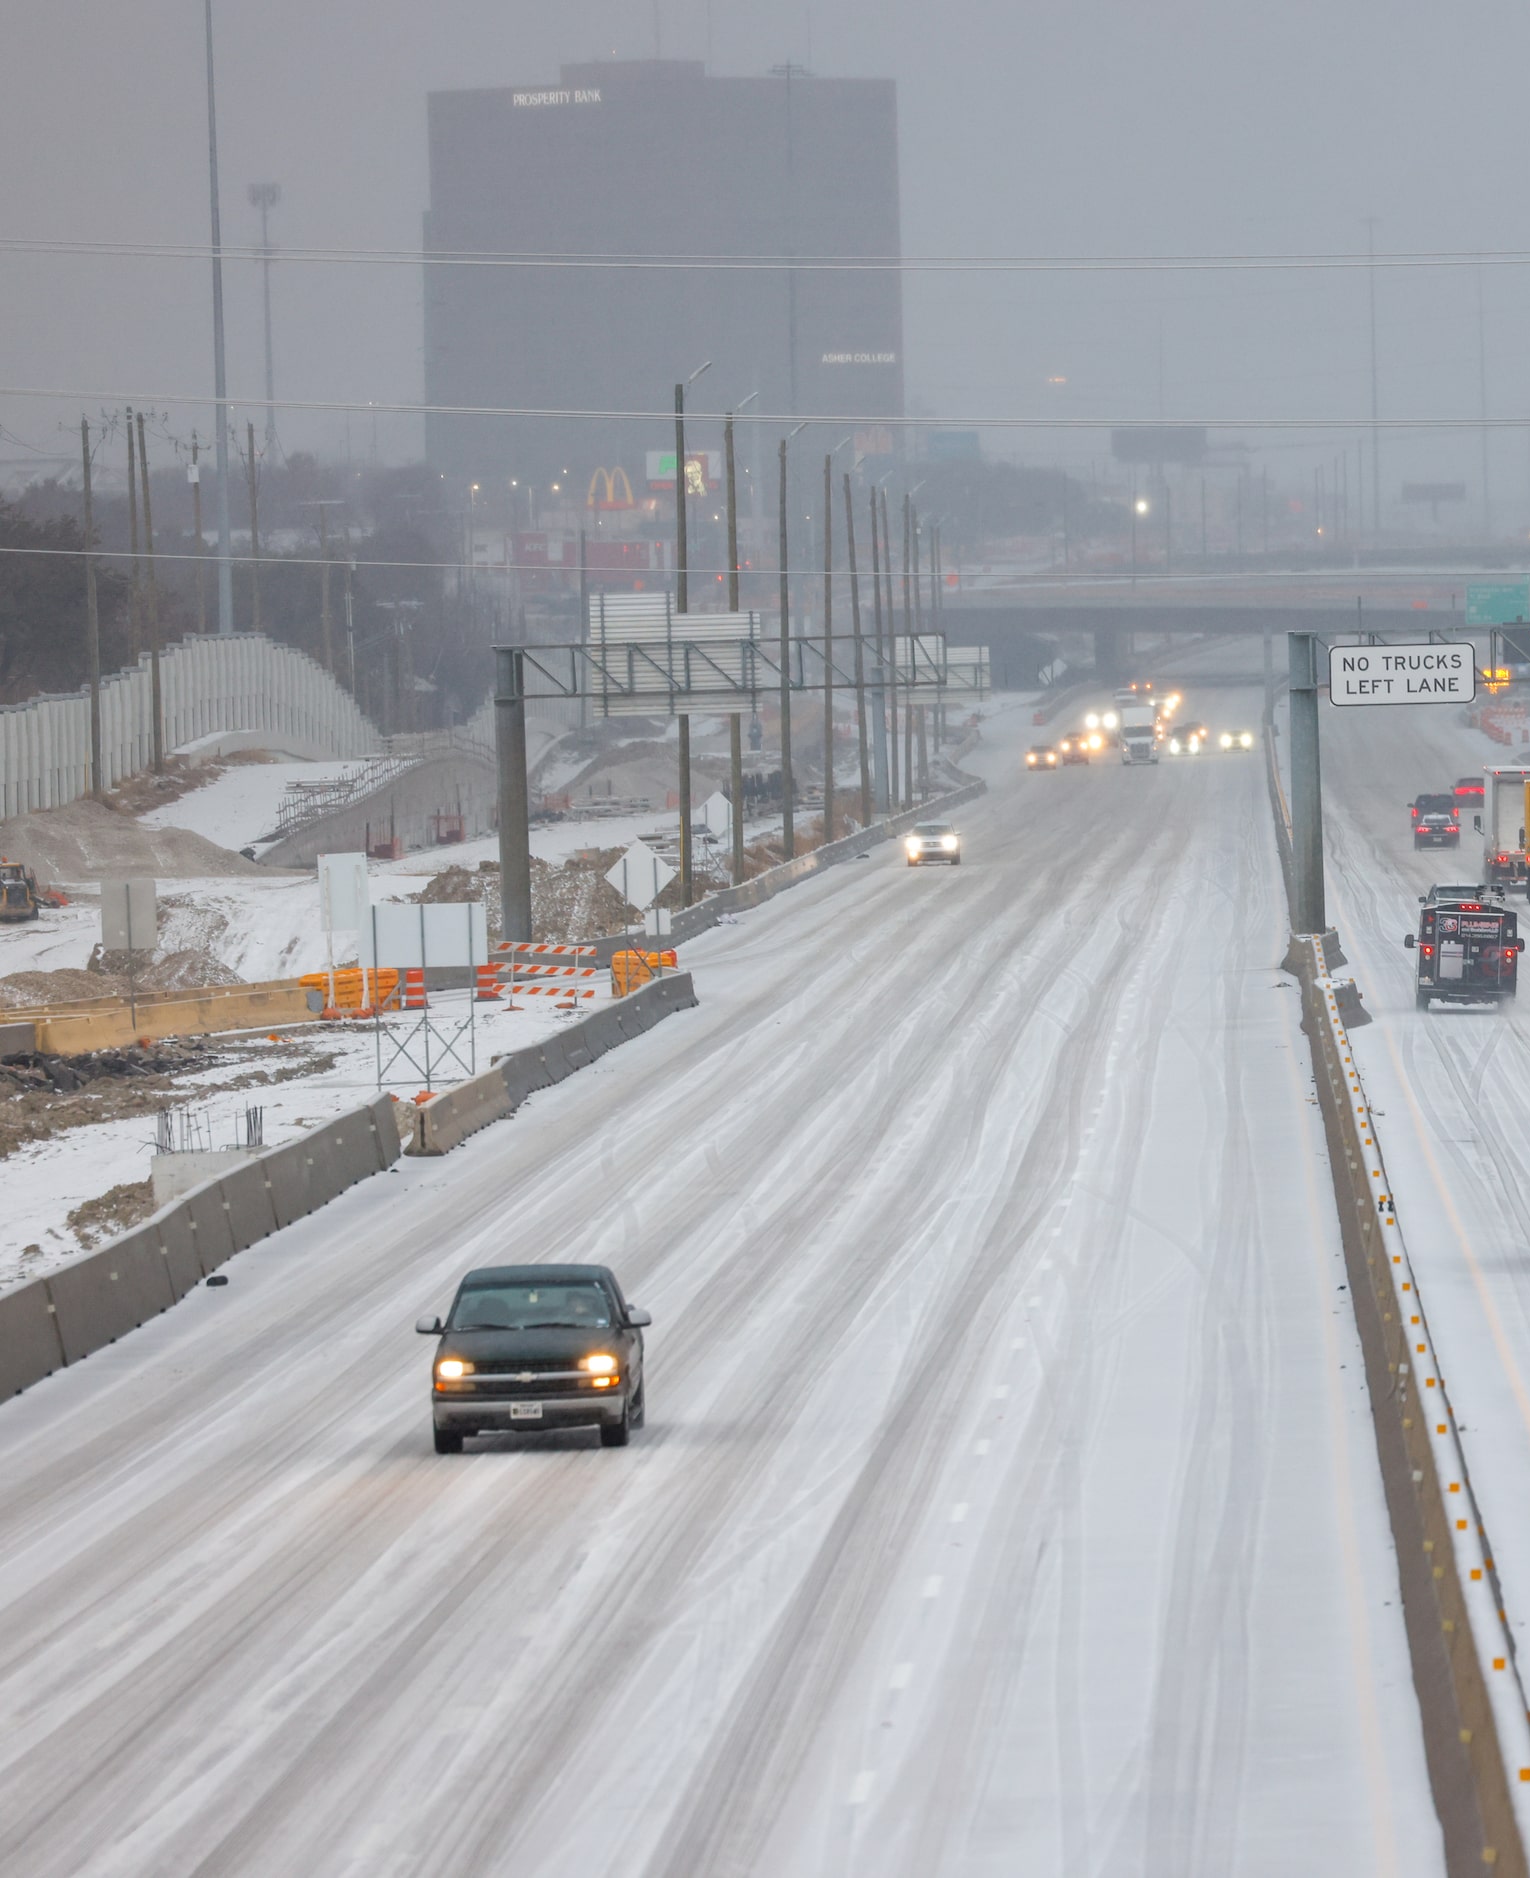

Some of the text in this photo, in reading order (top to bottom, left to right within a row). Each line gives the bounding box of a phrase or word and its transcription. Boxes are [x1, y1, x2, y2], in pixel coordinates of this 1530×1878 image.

[512, 88, 602, 106] PROSPERITY BANK
[821, 352, 896, 363] ASHER COLLEGE
[1342, 654, 1462, 672] NO TRUCKS
[1346, 677, 1460, 694] LEFT LANE
